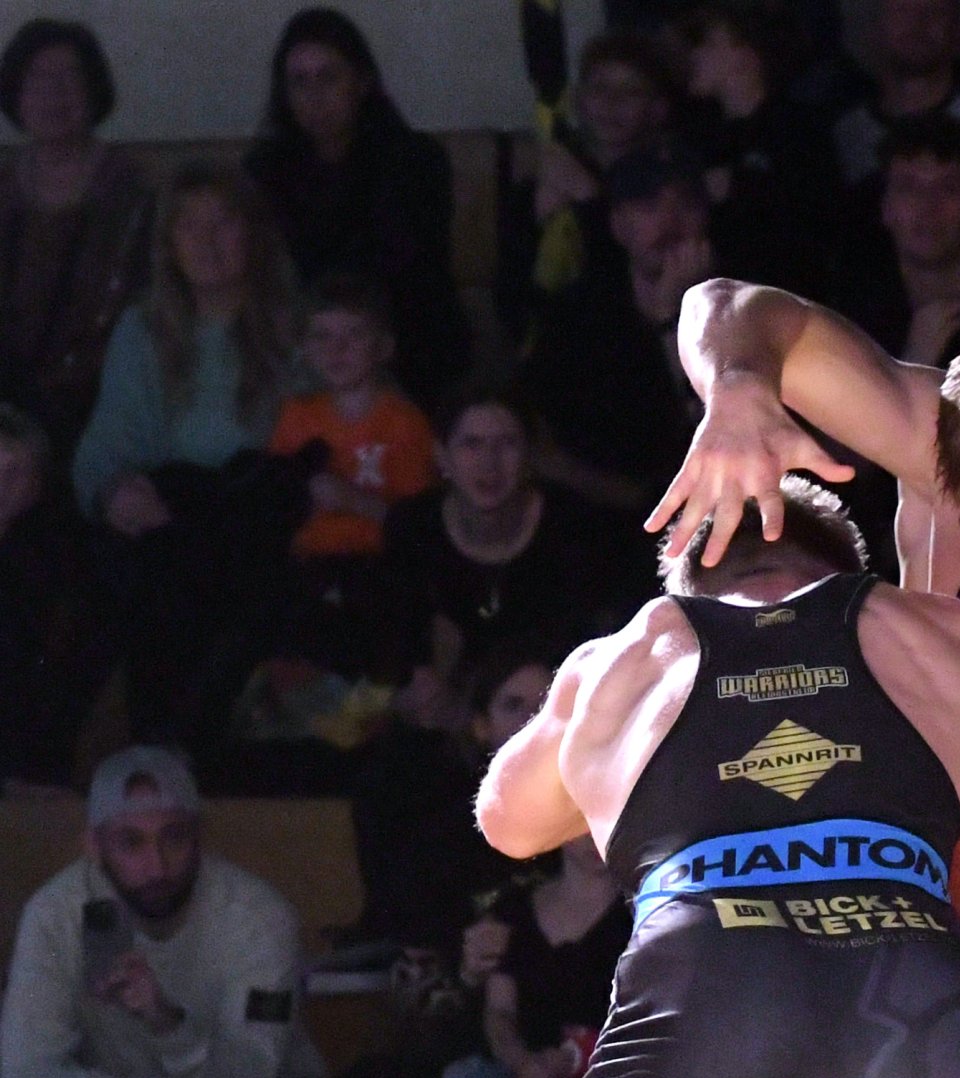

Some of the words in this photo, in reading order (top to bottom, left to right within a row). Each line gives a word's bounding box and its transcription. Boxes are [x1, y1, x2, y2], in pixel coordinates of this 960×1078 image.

[720, 667, 845, 695] WARRIORS
[723, 746, 857, 777] SPANNRIT
[660, 836, 948, 894] PHANTOM
[785, 895, 891, 917] BICK
[792, 911, 948, 935] LETZEL
